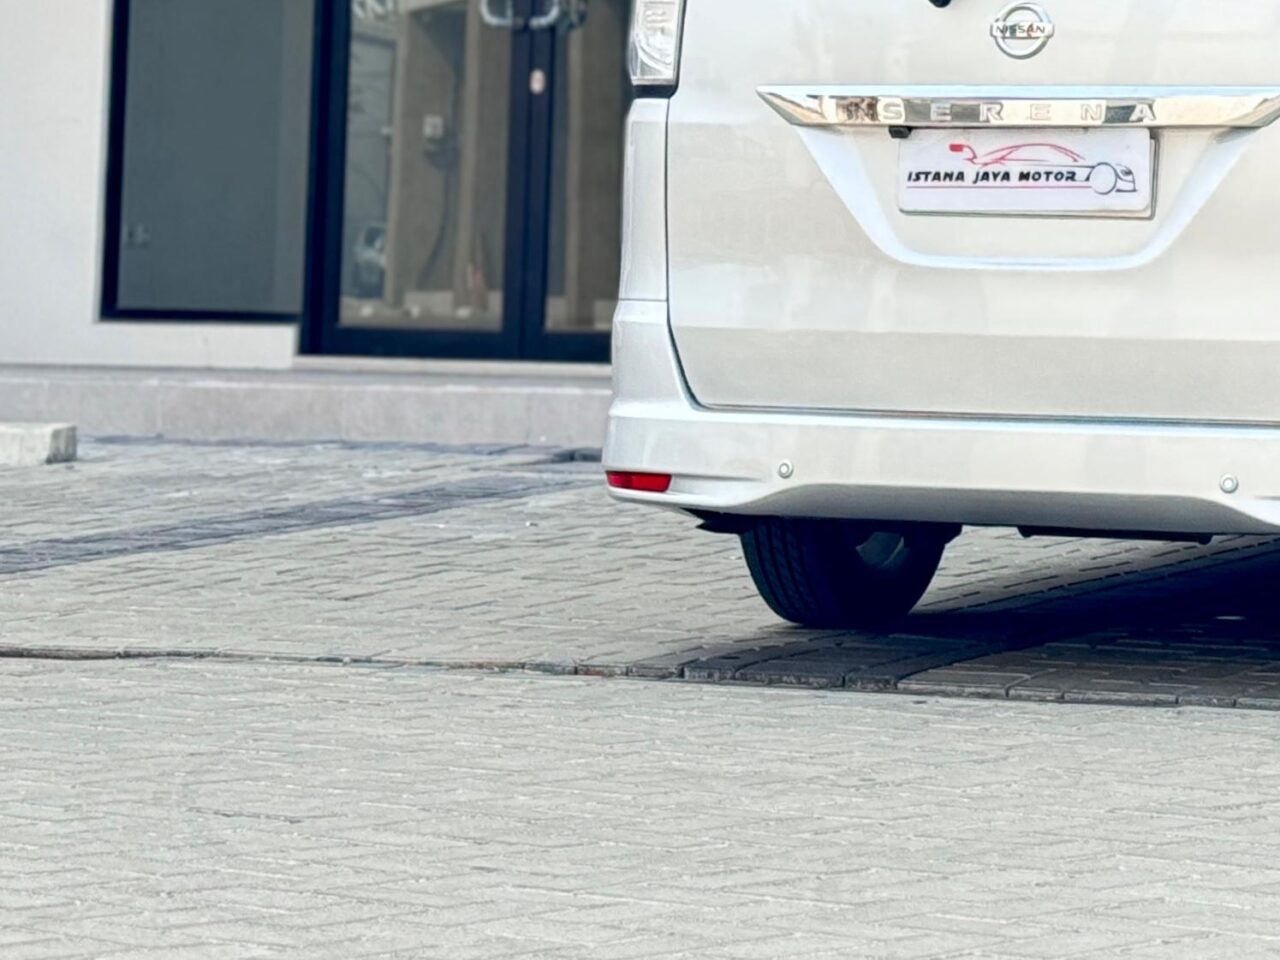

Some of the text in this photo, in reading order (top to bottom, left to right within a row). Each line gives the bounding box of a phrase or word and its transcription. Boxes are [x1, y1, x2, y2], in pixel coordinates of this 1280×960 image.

[995, 23, 1046, 35] NISSAN
[882, 102, 1157, 123] SERENA
[907, 170, 1077, 185] ISTANA JAYA MOTOR
